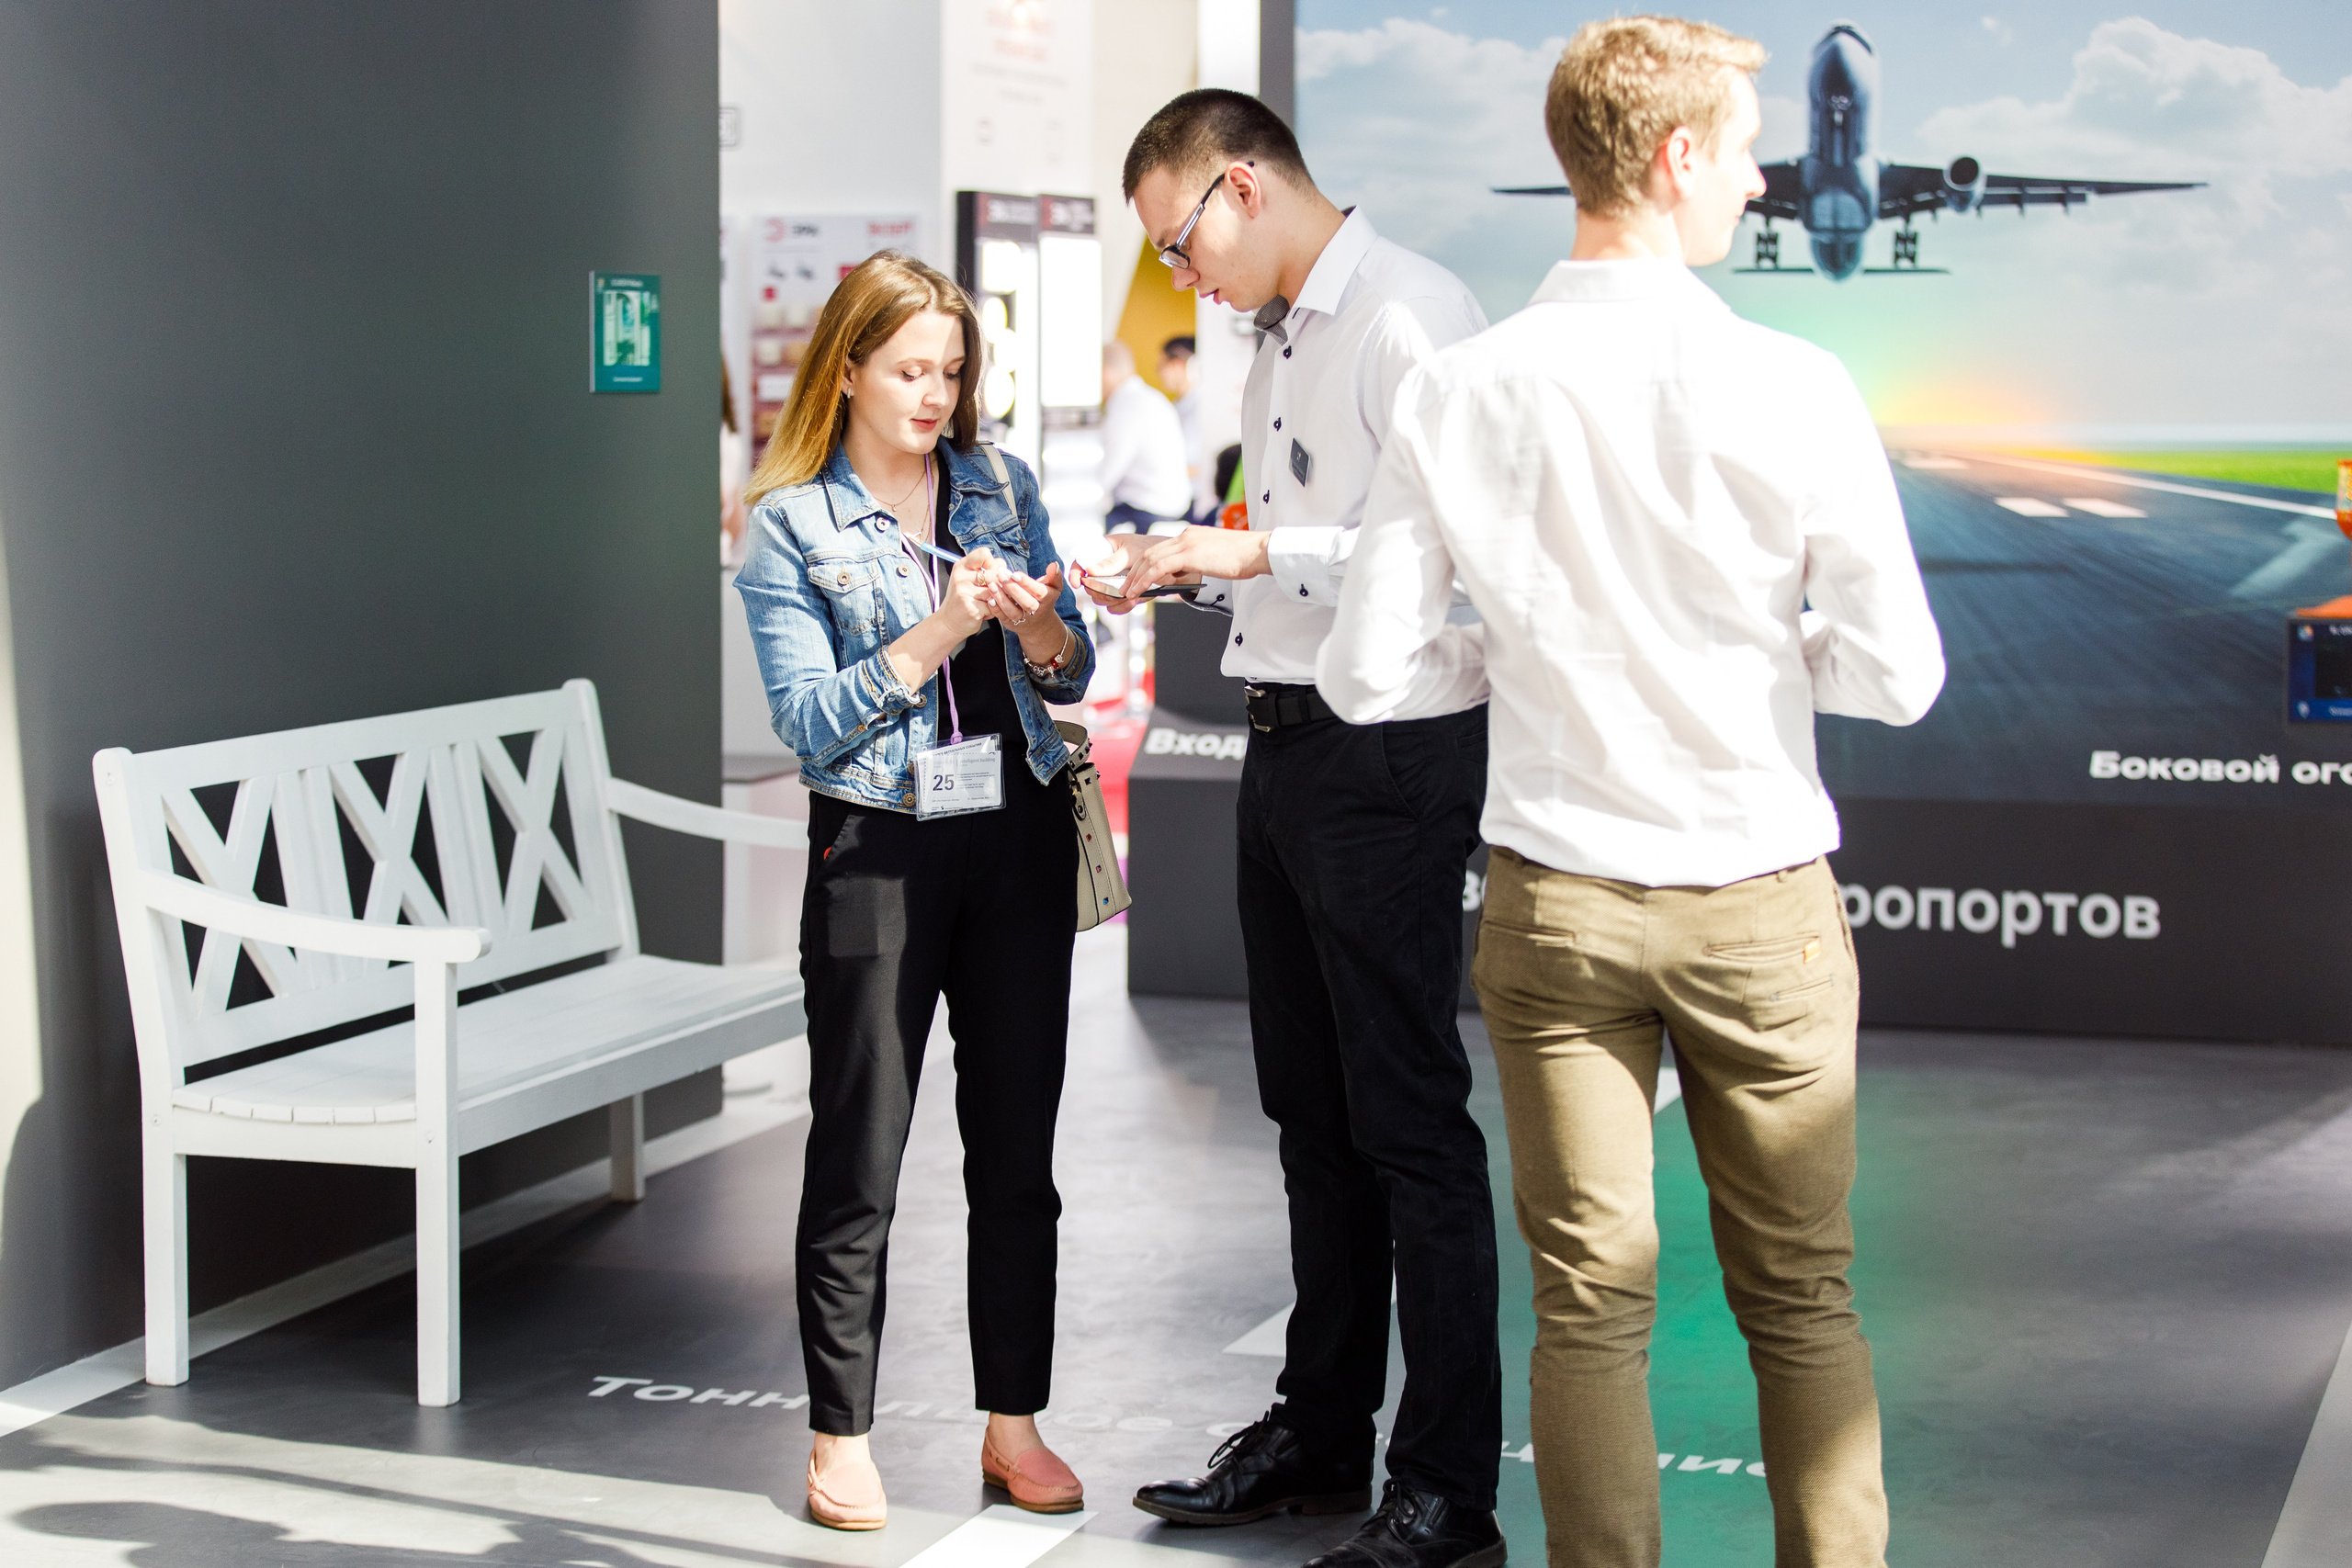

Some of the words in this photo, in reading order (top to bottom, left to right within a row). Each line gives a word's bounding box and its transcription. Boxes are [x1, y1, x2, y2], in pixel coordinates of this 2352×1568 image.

[1146, 728, 1247, 760] Вход
[933, 773, 955, 792] 25
[2089, 750, 2280, 784] Боковой
[1838, 883, 2161, 949] ропортов
